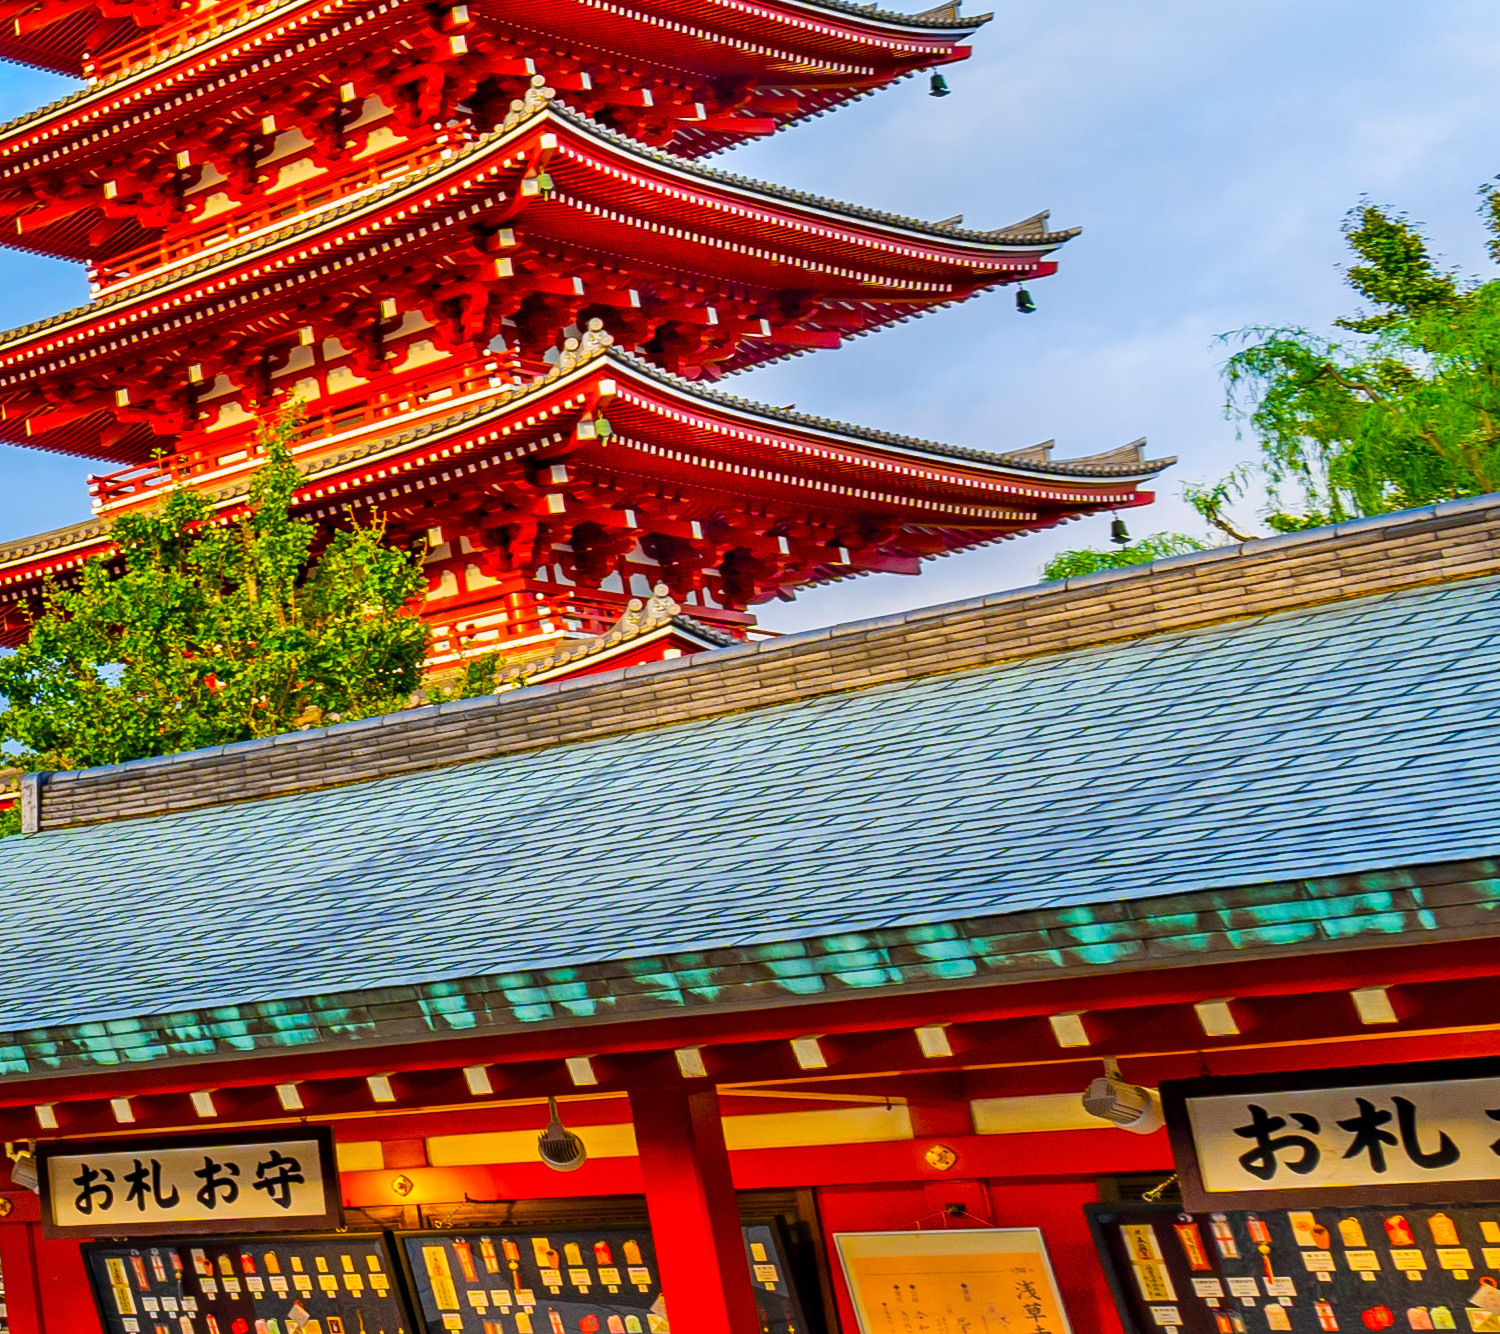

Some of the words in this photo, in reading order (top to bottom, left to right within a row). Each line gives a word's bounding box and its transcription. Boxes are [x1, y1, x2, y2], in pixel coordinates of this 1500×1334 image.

[1233, 1096, 1500, 1181] お札
[73, 1149, 306, 1216] お札お守
